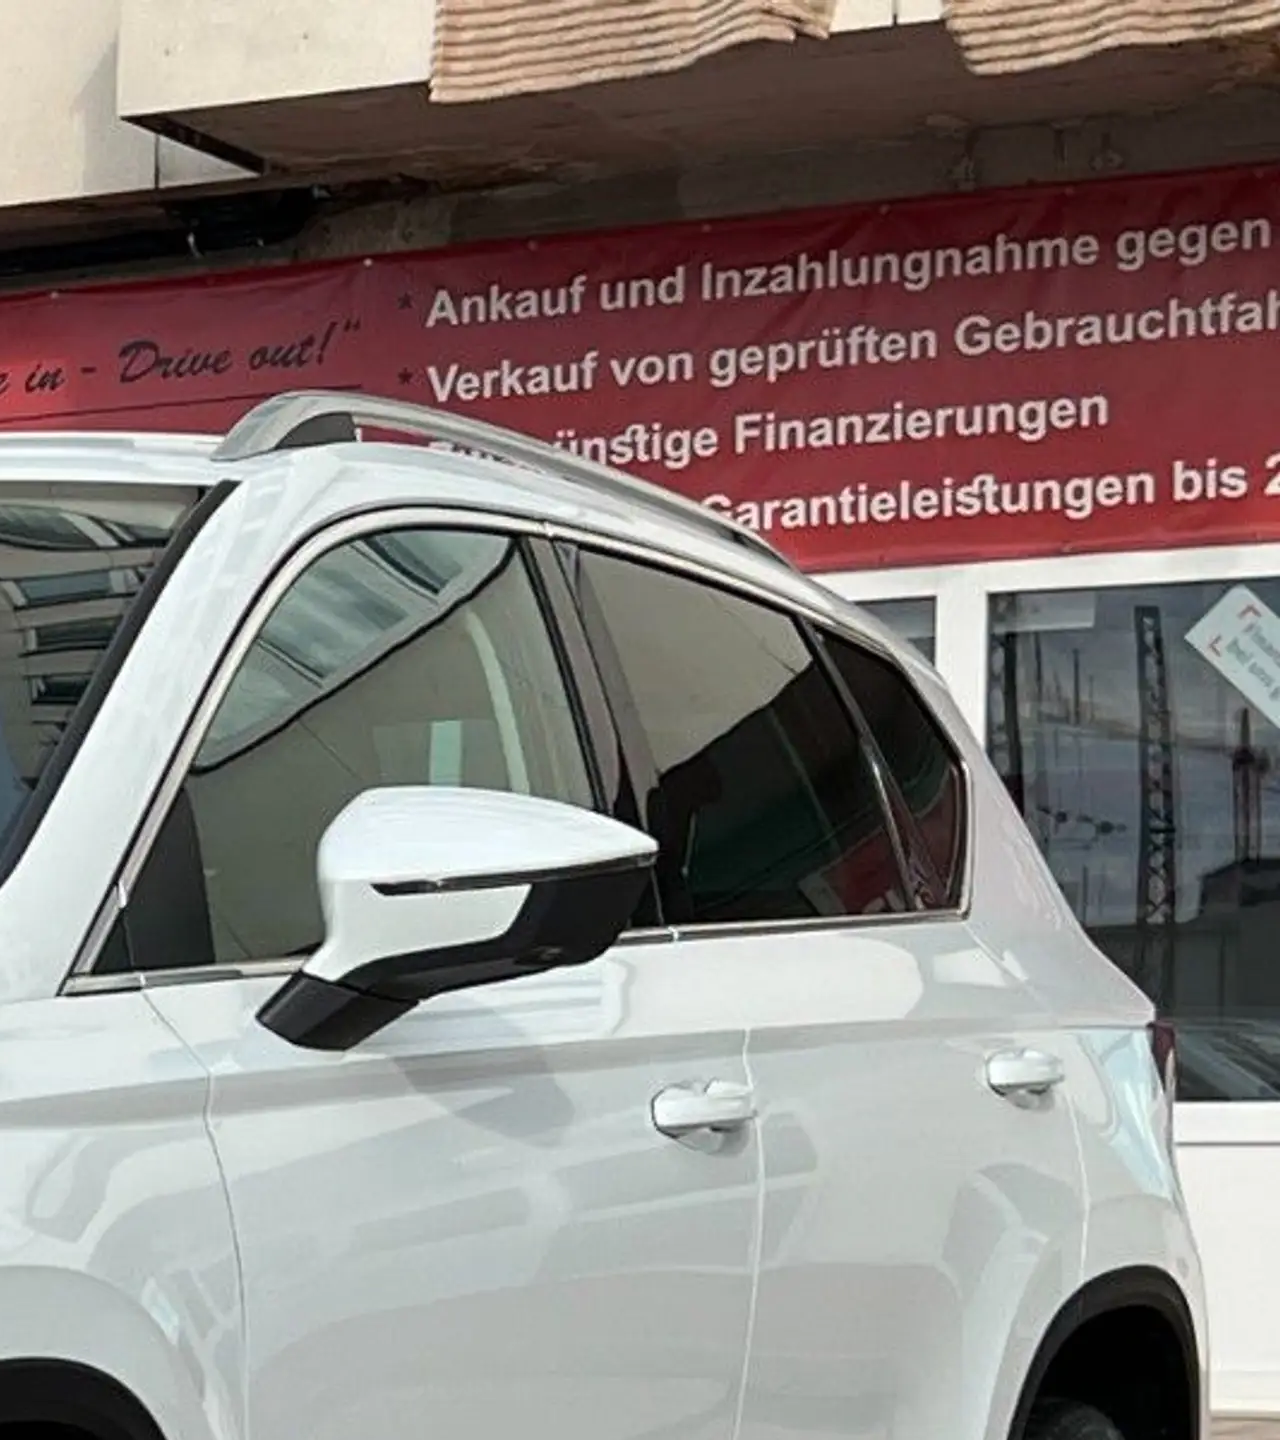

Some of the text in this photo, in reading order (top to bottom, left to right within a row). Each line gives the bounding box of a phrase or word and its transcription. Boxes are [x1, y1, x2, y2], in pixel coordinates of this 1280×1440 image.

[425, 216, 1272, 328] Ankauf und Inzahlungnahme gegen
[24, 364, 65, 393] in
[119, 340, 233, 383] Drive
[426, 351, 599, 403] Verkauf
[609, 351, 695, 387] von
[708, 325, 938, 388] geprüften
[548, 422, 721, 470] ünstige
[734, 393, 1109, 455] Finanzierungen
[1172, 456, 1248, 501] bis
